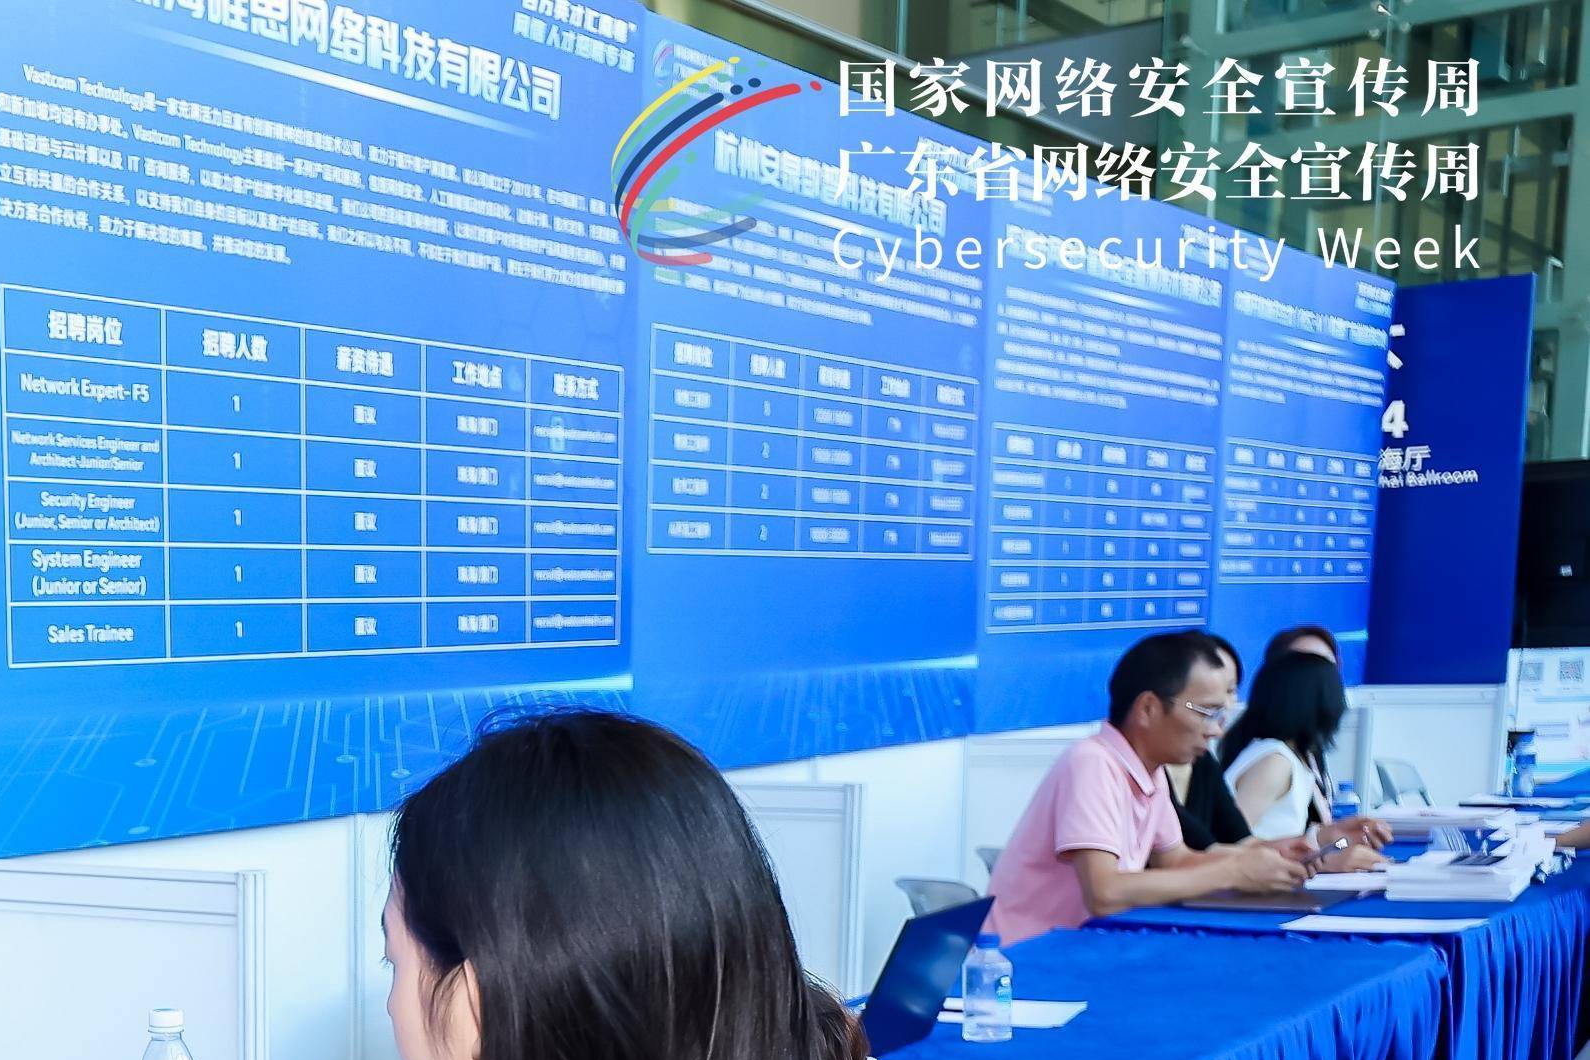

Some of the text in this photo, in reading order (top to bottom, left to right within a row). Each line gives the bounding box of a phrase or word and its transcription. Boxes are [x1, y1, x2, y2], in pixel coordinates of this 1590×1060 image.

[132, 0, 562, 120] 唯思网络科技有限公司
[47, 309, 123, 346] 招聘岗位
[20, 373, 81, 396] Network
[132, 383, 150, 403] F5
[232, 395, 240, 412] 1
[232, 452, 241, 469] 1
[1405, 469, 1479, 488] Ballroom
[40, 491, 136, 513] Security Engineer
[233, 509, 242, 526] 1
[31, 548, 142, 573] System Engineer
[234, 565, 242, 582] 1
[32, 575, 147, 597] (Junior or Senior)
[48, 624, 134, 644] Sales Trainee
[235, 621, 243, 638] 1
